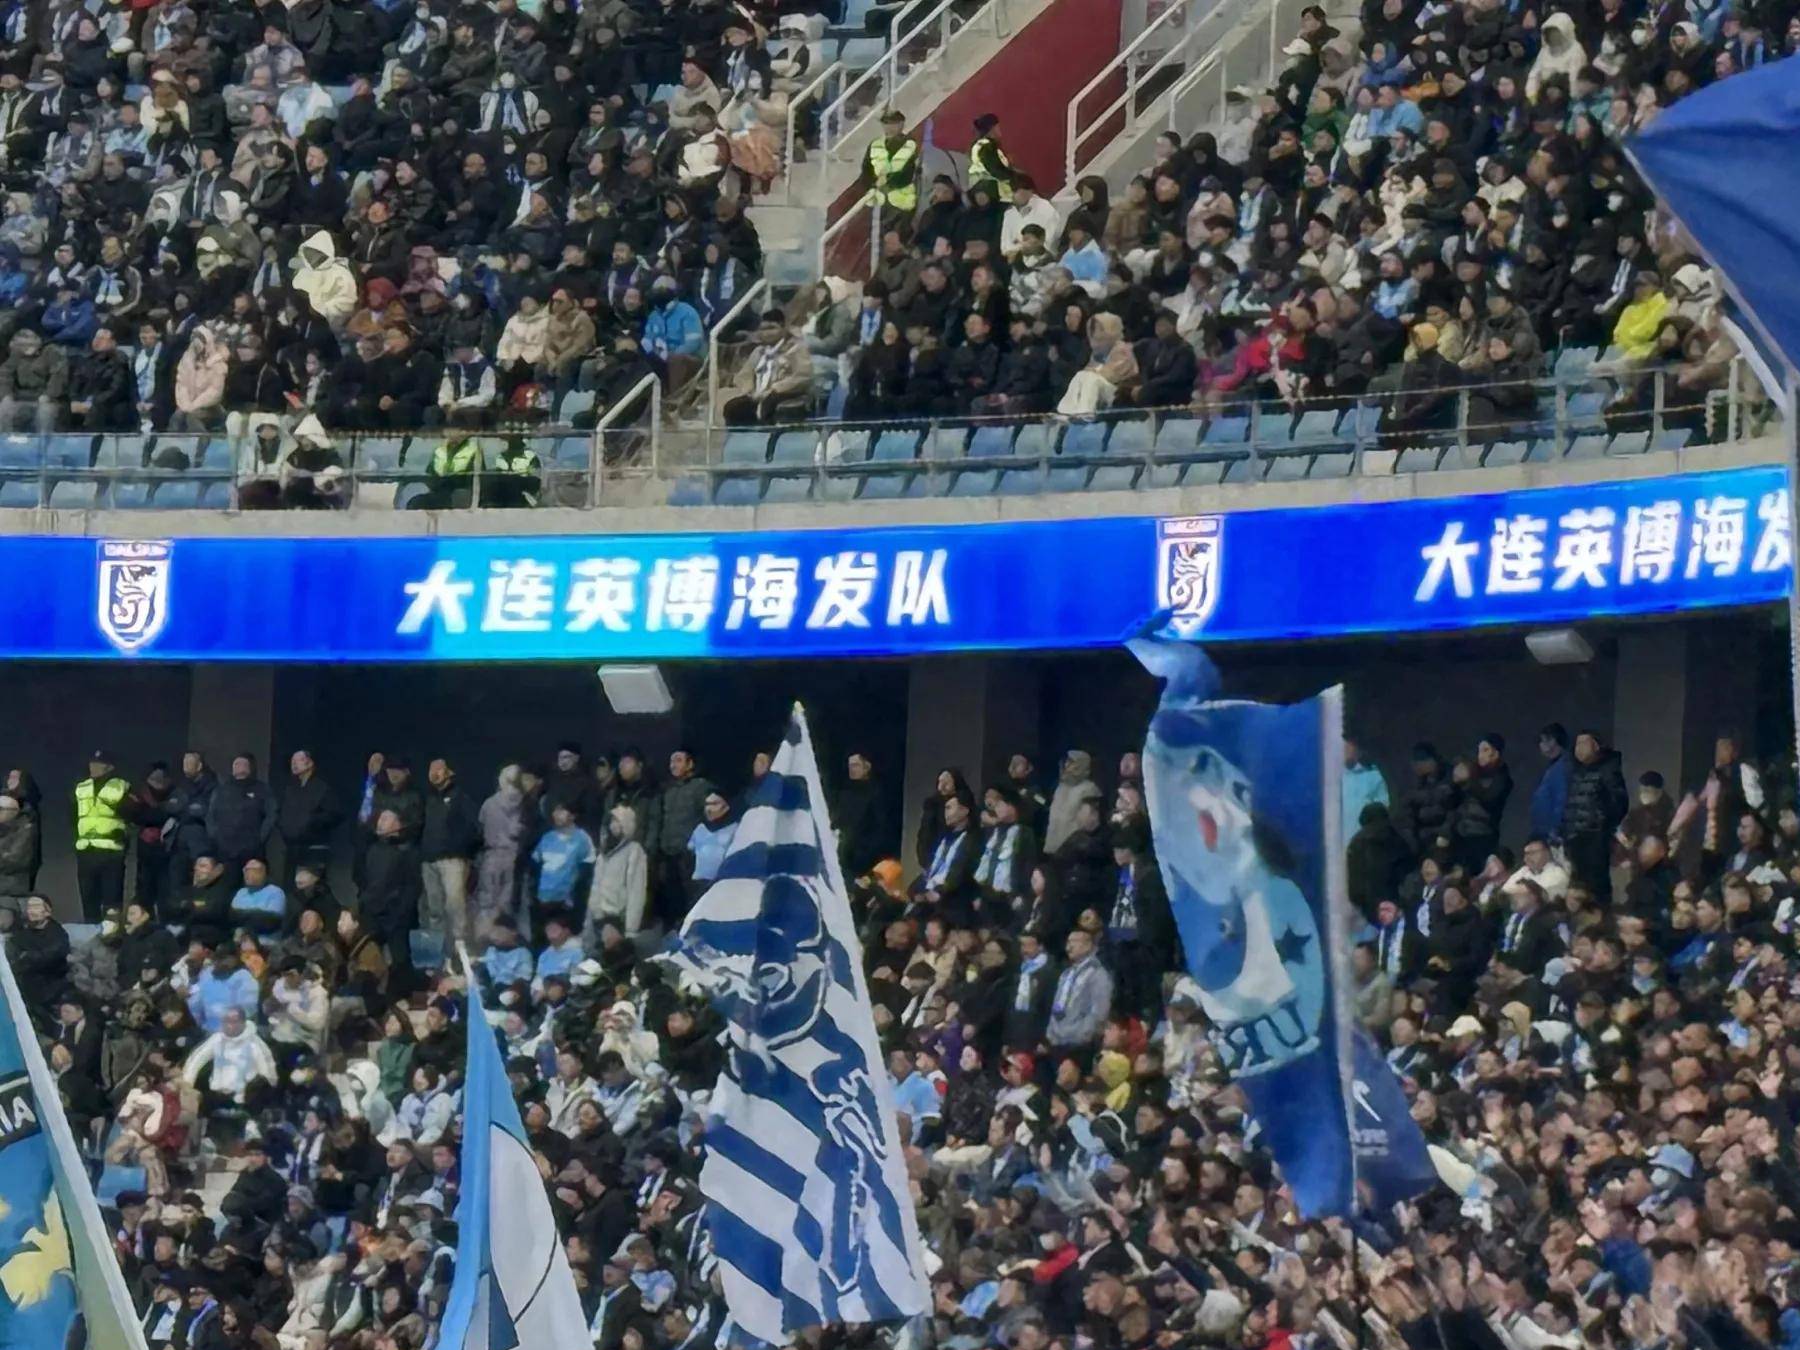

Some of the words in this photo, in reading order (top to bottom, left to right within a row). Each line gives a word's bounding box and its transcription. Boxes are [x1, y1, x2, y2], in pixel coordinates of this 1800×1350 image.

[396, 548, 953, 635] 大连英博海发队
